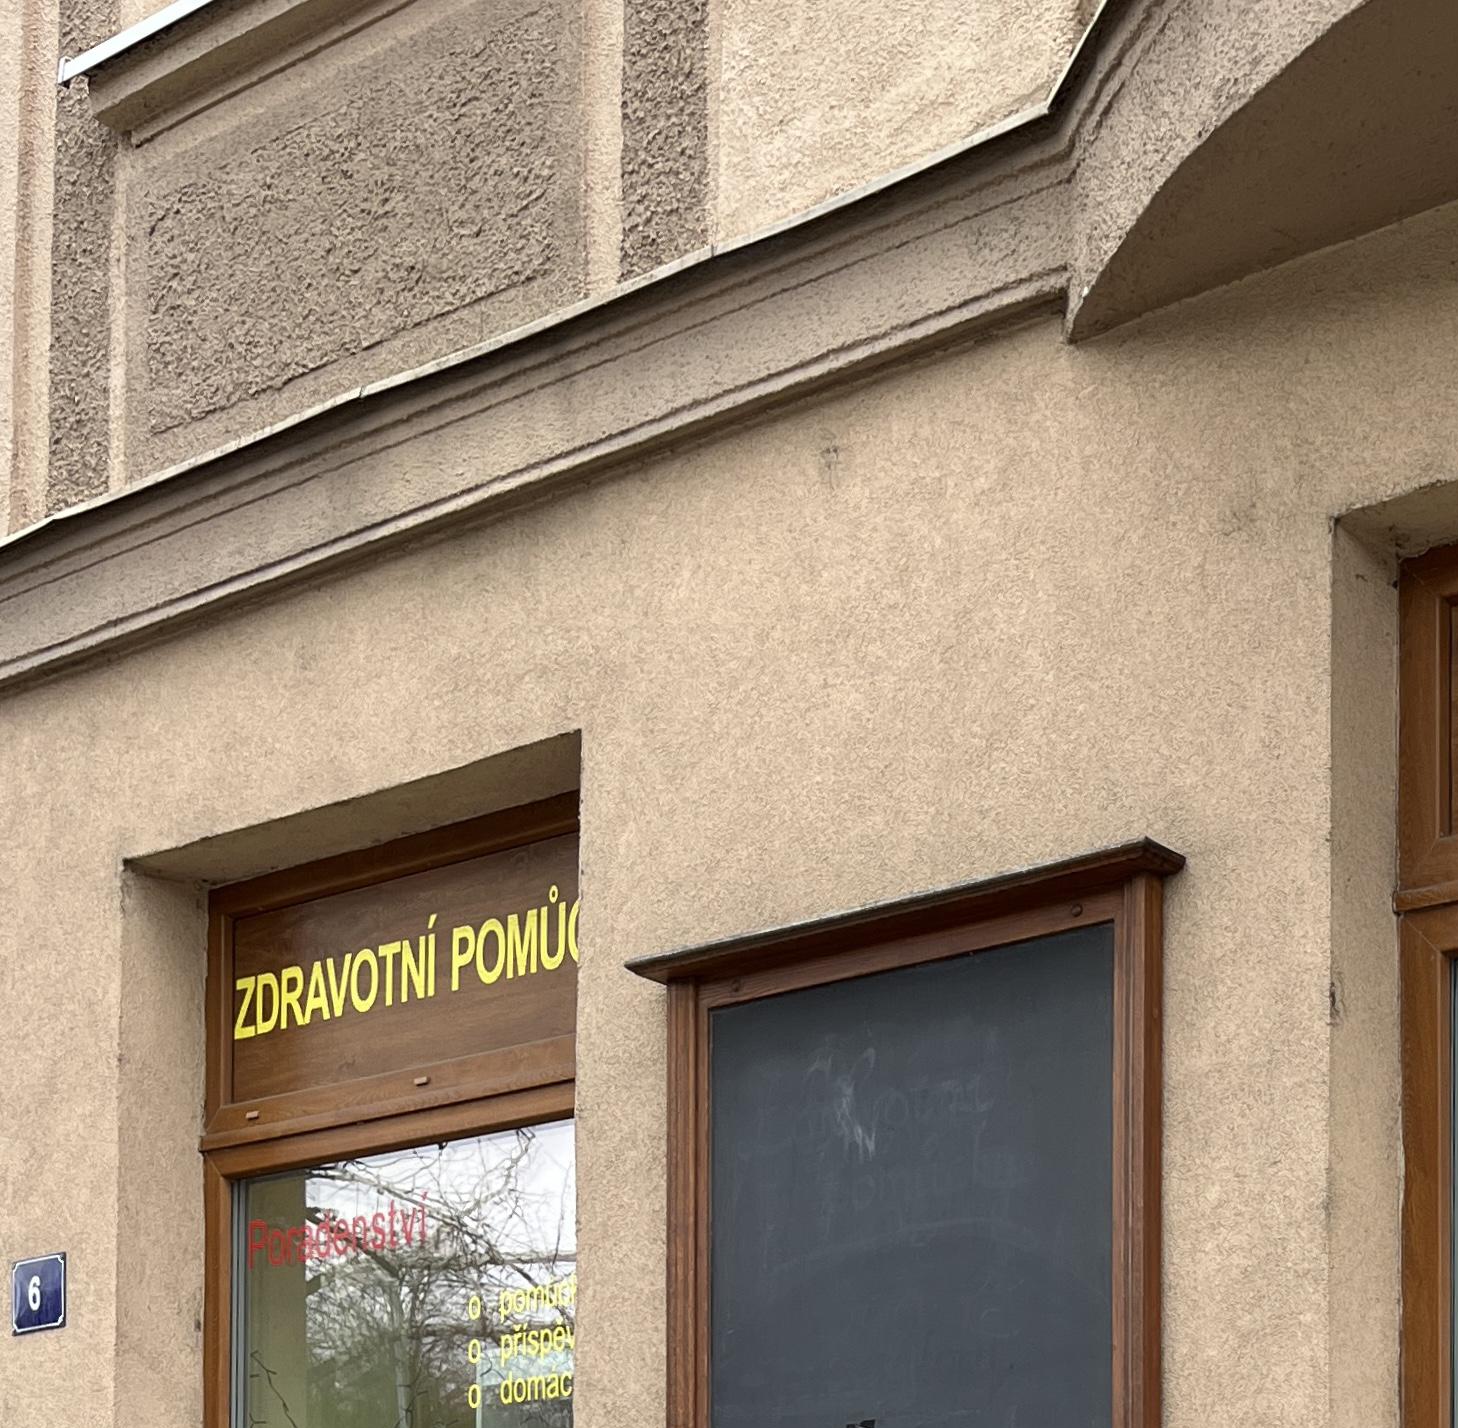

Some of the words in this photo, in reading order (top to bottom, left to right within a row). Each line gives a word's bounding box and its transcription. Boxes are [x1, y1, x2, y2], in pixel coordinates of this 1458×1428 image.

[234, 914, 438, 1040] ZDRAVOTNÍ
[247, 1190, 428, 1272] Poradenství
[28, 1275, 41, 1311] 6
[467, 1338, 481, 1364] o
[467, 1383, 481, 1409] o
[500, 1364, 573, 1405] domác
